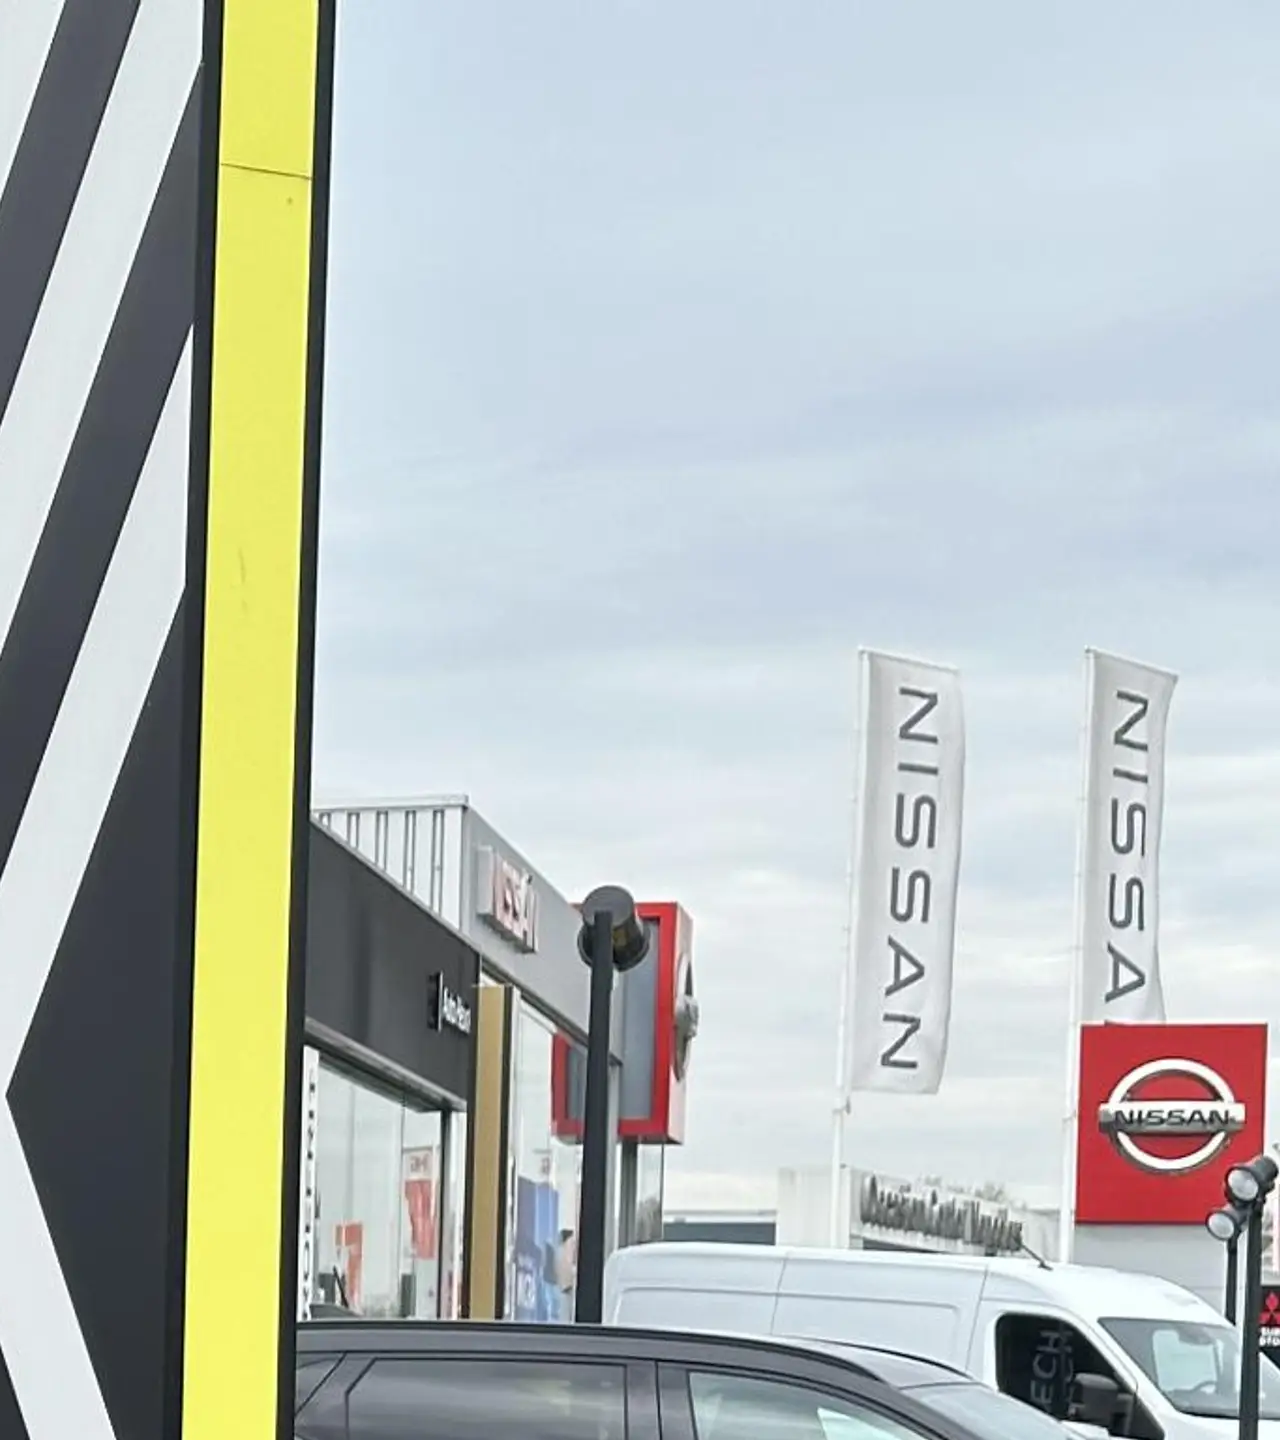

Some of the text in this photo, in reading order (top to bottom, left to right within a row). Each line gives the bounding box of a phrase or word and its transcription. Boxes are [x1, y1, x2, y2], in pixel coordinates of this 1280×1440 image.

[880, 686, 939, 1070] NISSAN
[1104, 689, 1150, 1027] NISSA
[1114, 1109, 1231, 1126] NISSAN
